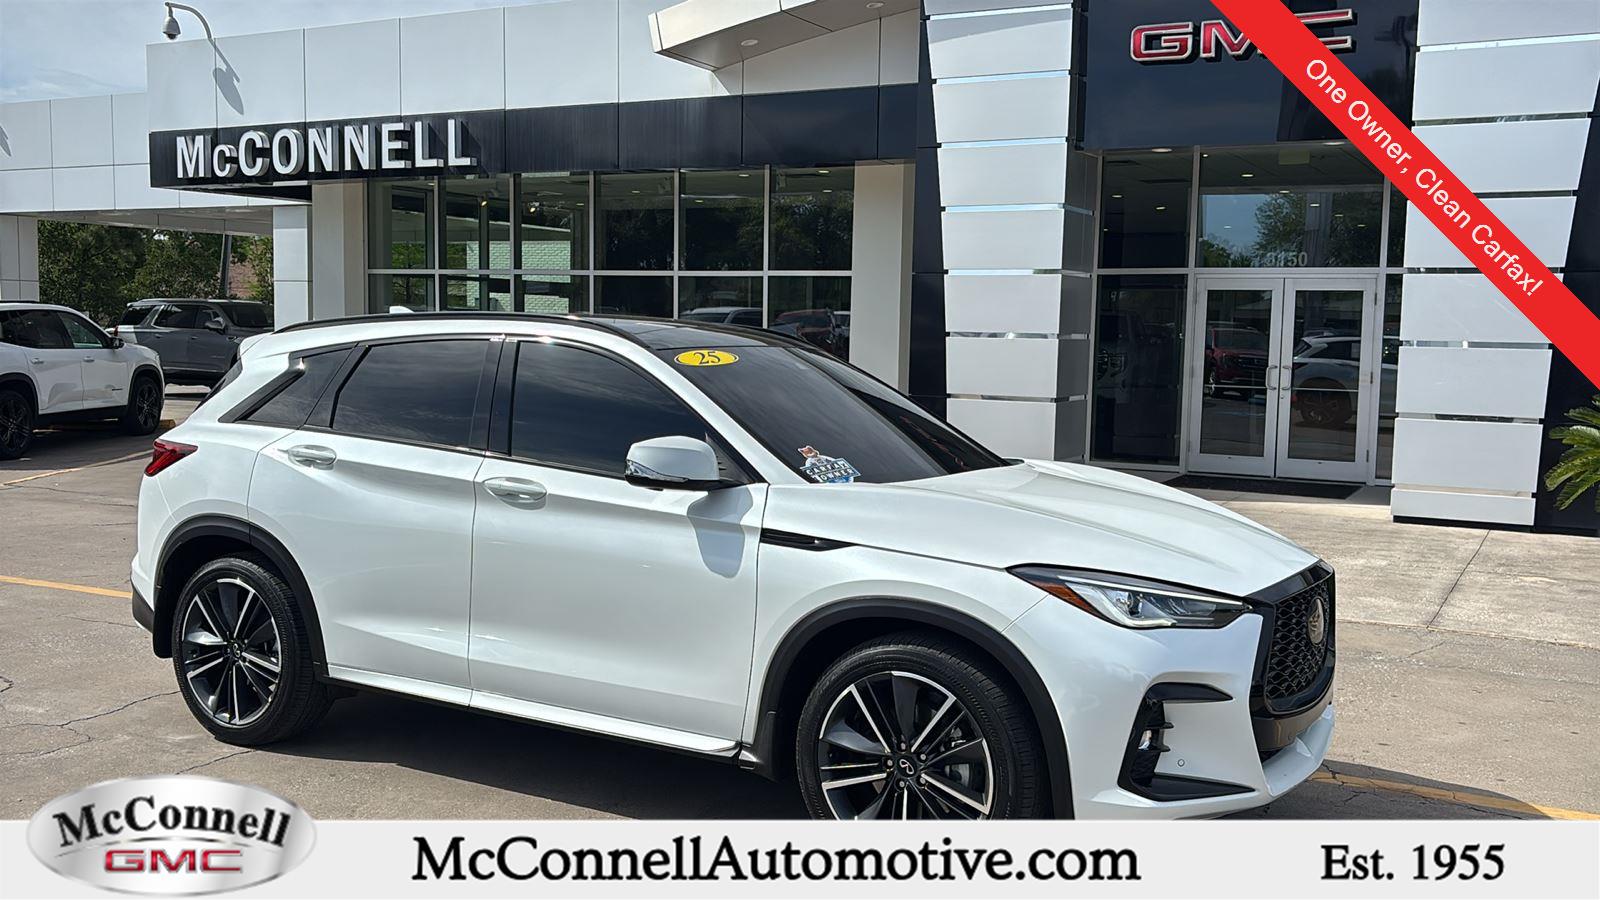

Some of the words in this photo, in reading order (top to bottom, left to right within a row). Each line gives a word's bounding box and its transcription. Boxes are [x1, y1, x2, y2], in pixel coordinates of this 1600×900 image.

[176, 118, 475, 179] McCONNELL
[693, 351, 721, 365] 25
[806, 460, 851, 475] CARFAX
[820, 468, 855, 481] OWNER
